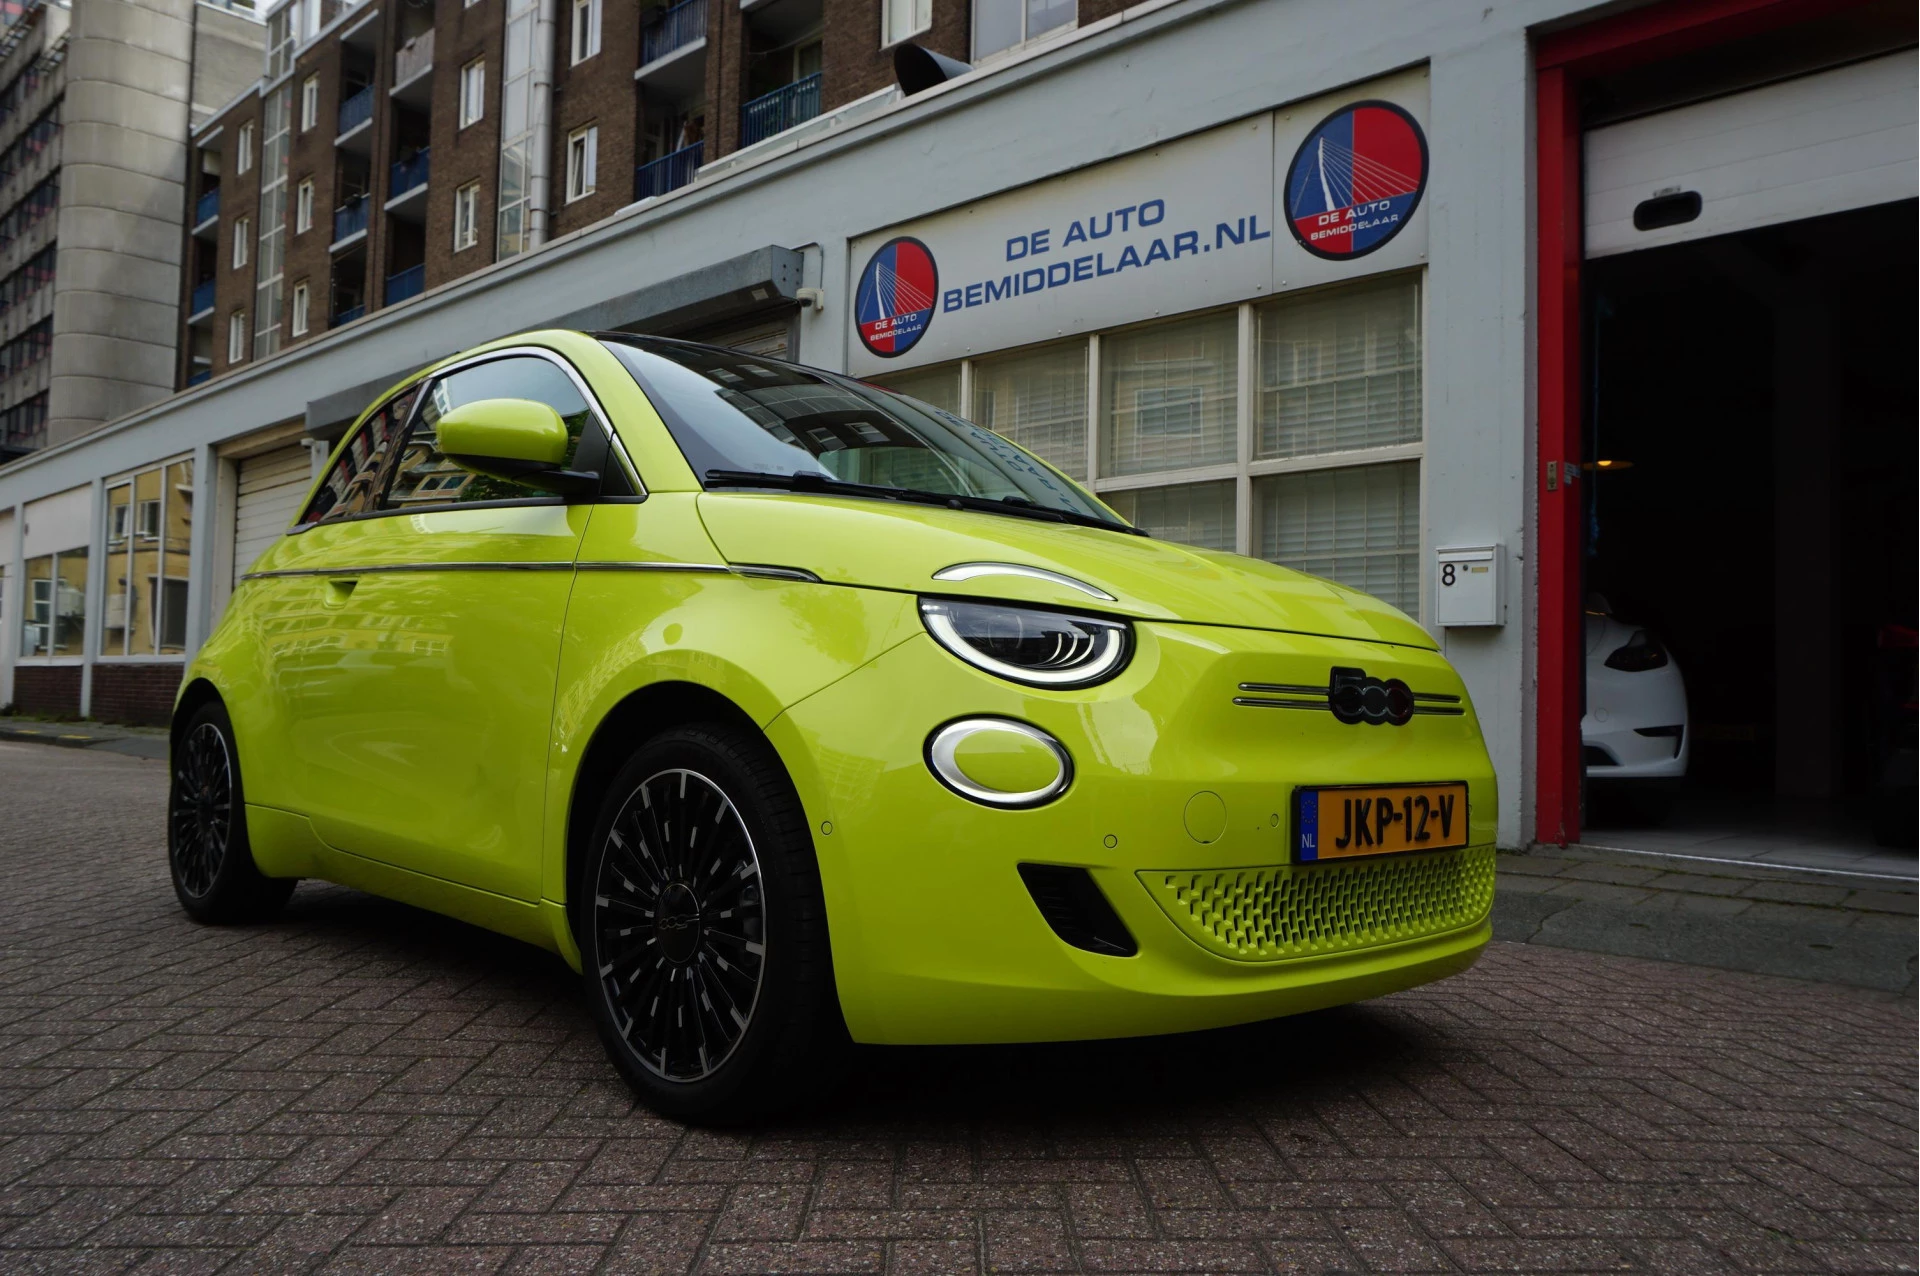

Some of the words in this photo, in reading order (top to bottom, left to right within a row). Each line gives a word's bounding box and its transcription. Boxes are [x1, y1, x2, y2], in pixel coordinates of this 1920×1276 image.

[1318, 212, 1340, 226] DE
[1345, 200, 1390, 219] AUTO
[1006, 228, 1050, 261] DE
[1062, 199, 1165, 247] AUTO
[1310, 214, 1399, 241] BEMIDDELAAR
[943, 215, 1271, 313] BEMIDDELAAR.NL
[870, 325, 922, 341] BEMIDDELAAR
[875, 321, 888, 330] DE
[891, 314, 917, 326] AUTO
[1441, 563, 1456, 587] 8
[1329, 666, 1415, 726] 500
[1301, 833, 1316, 849] NL
[1335, 794, 1455, 849] JKP-12-V
